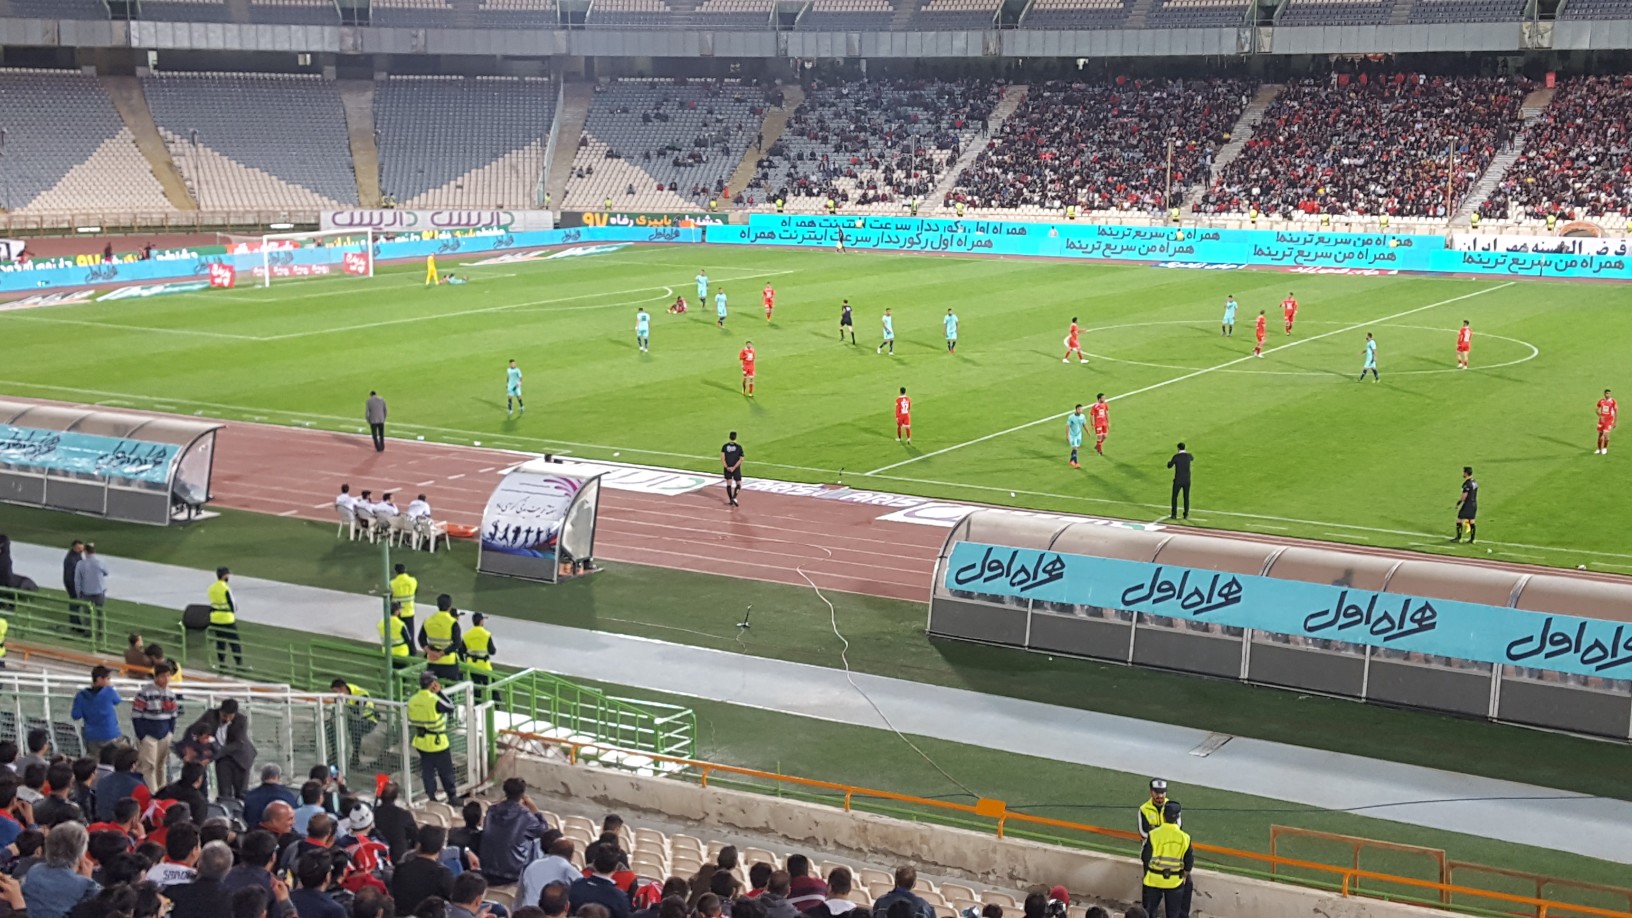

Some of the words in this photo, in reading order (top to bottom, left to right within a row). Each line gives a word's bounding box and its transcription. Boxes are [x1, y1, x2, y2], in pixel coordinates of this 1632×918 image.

[739, 227, 776, 243] همراه
[930, 232, 954, 250] اول
[956, 234, 993, 251] همراه
[1159, 241, 1195, 258] همراه
[1375, 234, 1413, 248] هماه
[1587, 239, 1627, 256] قض
[1357, 247, 1397, 265] همراه
[1580, 254, 1625, 273] همراه
[954, 546, 1019, 585] اول
[1009, 552, 1066, 592] همراه
[1120, 566, 1191, 607] اول
[1180, 573, 1243, 616] همراه
[1303, 590, 1379, 633] اول
[1369, 597, 1438, 642] همراه
[1505, 616, 1588, 662] اول
[1580, 625, 1632, 672] راه
